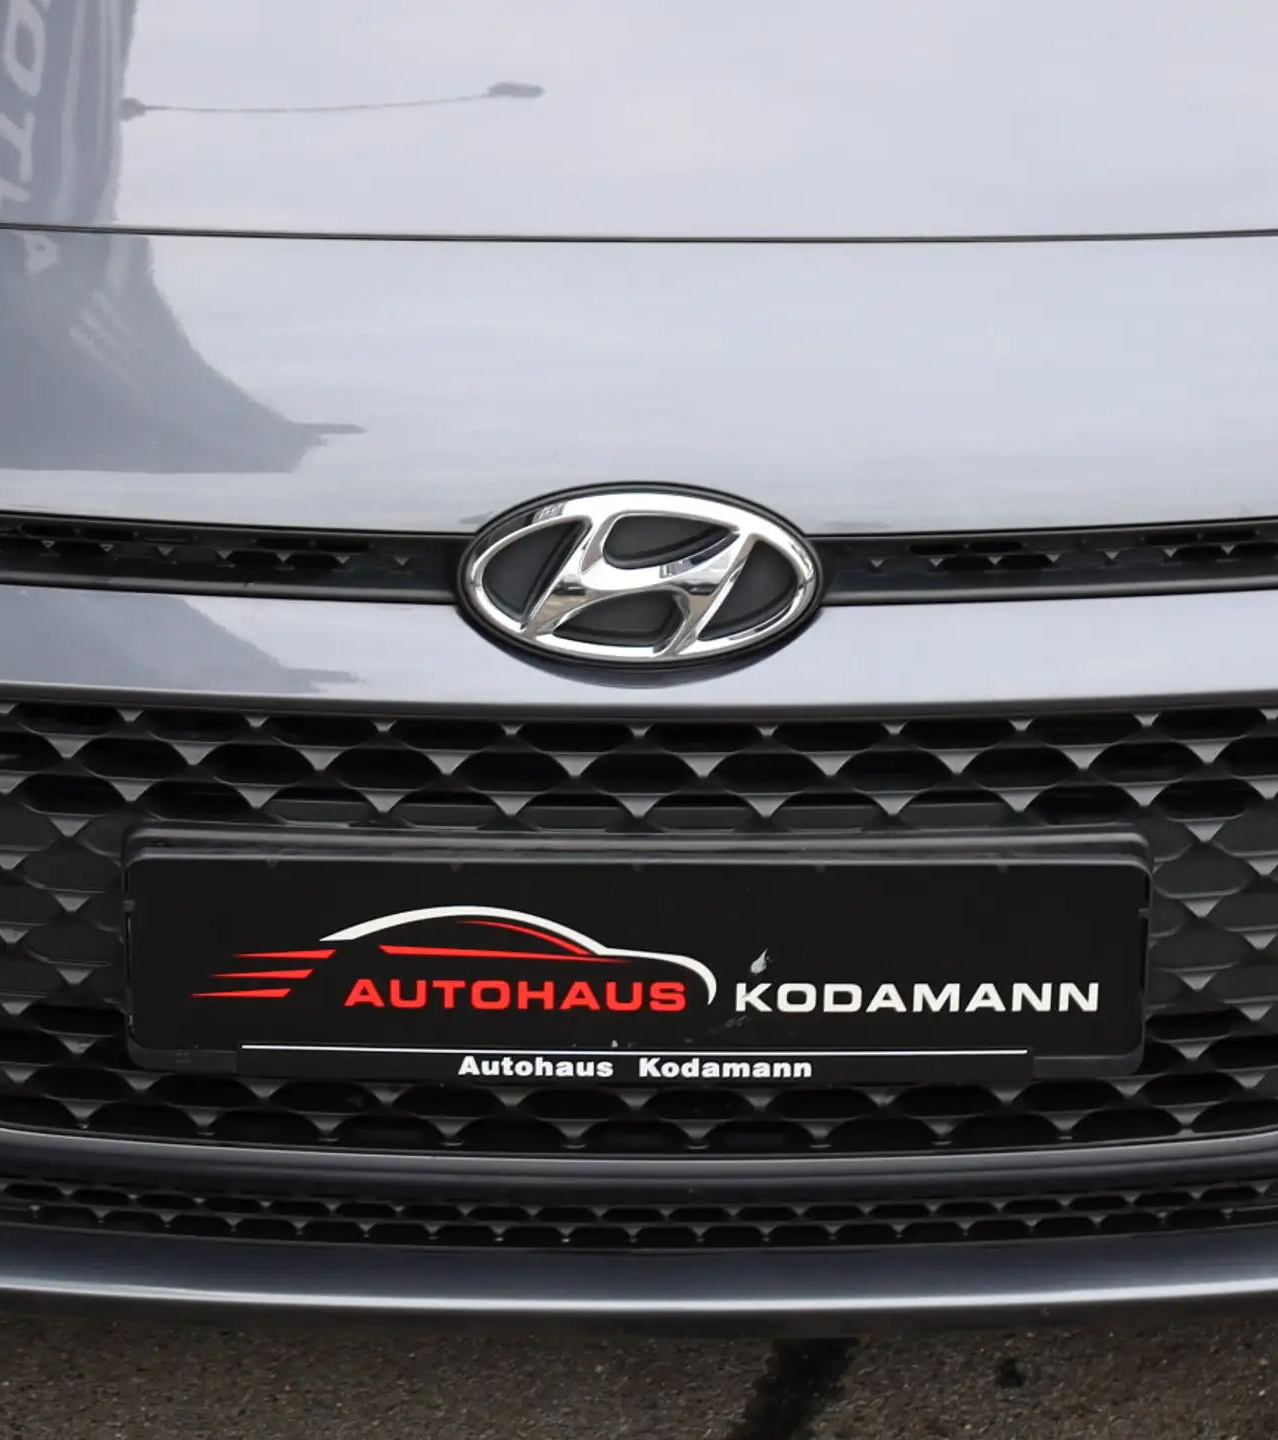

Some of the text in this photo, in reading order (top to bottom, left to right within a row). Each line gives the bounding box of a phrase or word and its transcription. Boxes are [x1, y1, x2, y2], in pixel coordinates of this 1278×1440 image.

[343, 977, 1100, 1014] AUTOHAUS KODAMANN
[457, 1055, 813, 1079] Autohaus Kodamann
